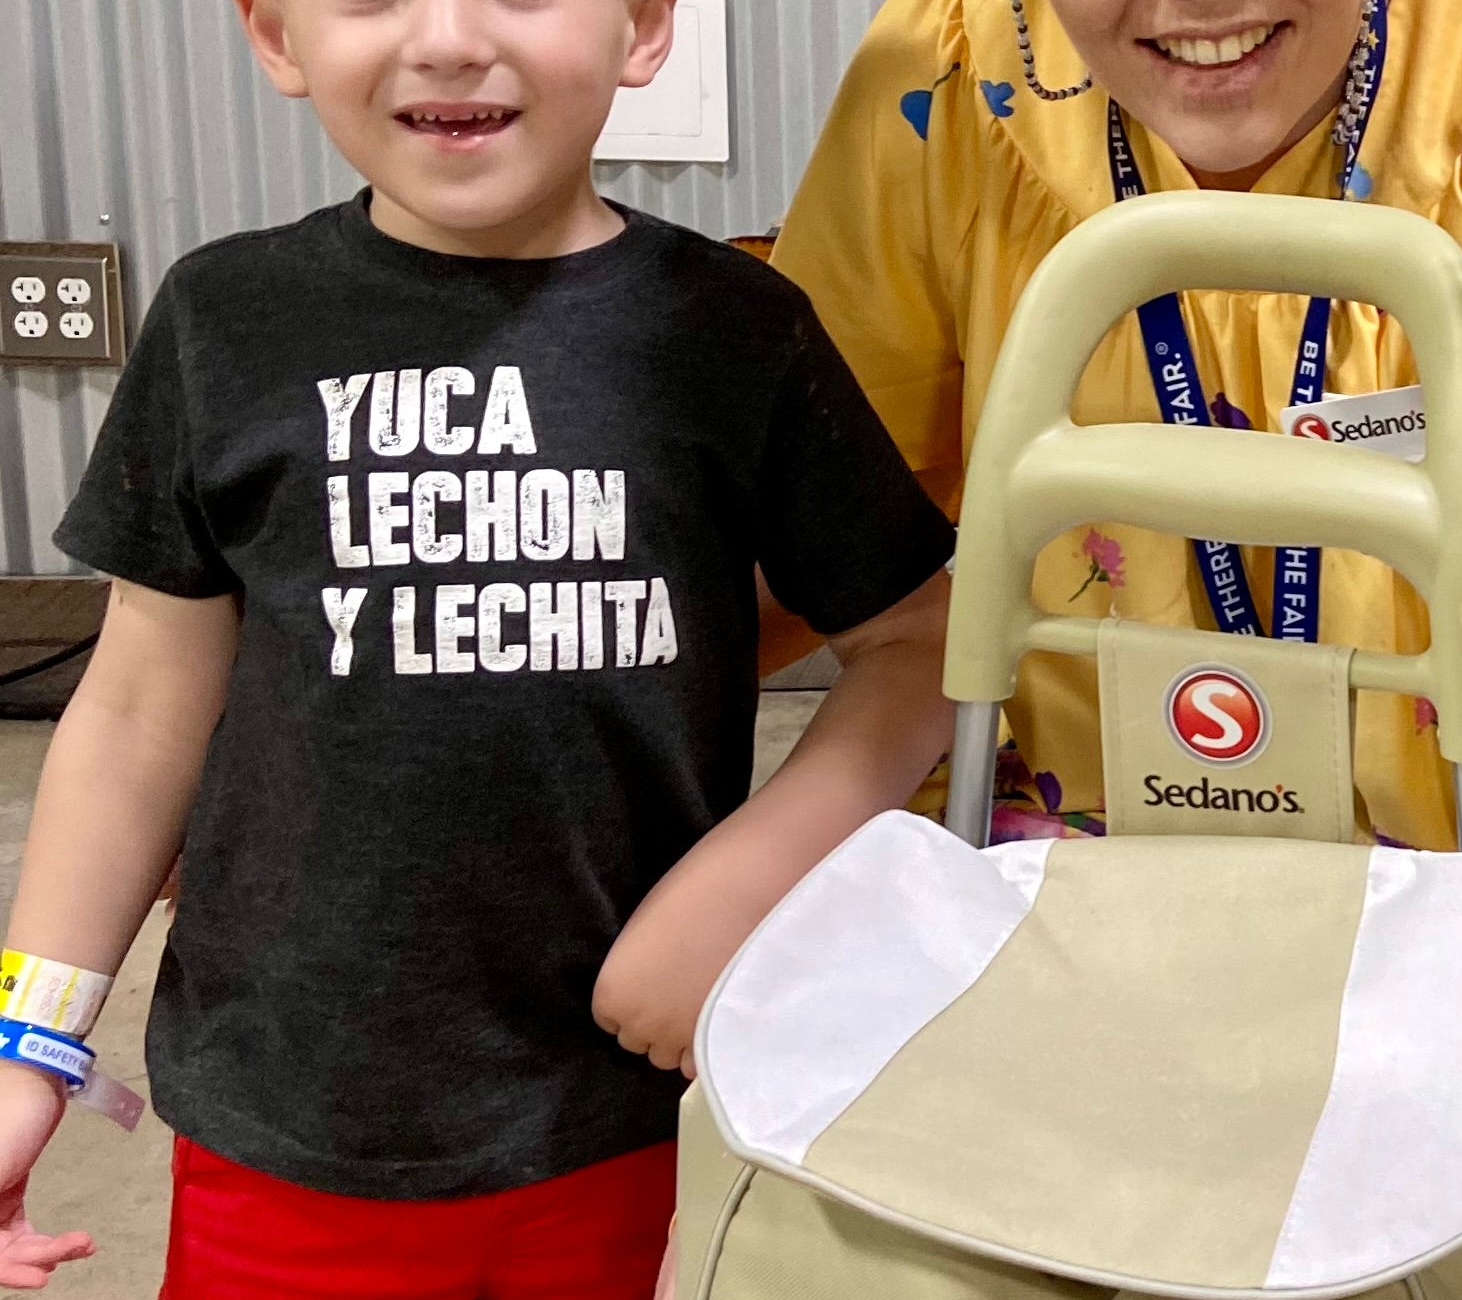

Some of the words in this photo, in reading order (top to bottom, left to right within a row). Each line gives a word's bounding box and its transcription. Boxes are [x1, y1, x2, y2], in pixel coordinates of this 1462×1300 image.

[1300, 340, 1319, 378] BE
[317, 366, 538, 461] YUCA
[1331, 411, 1427, 443] Sedano's
[326, 469, 626, 568] LECHON
[1284, 545, 1307, 584] HE
[321, 587, 368, 676] Y
[392, 577, 679, 675] LECHITA
[1144, 774, 1300, 814] Sedano's
